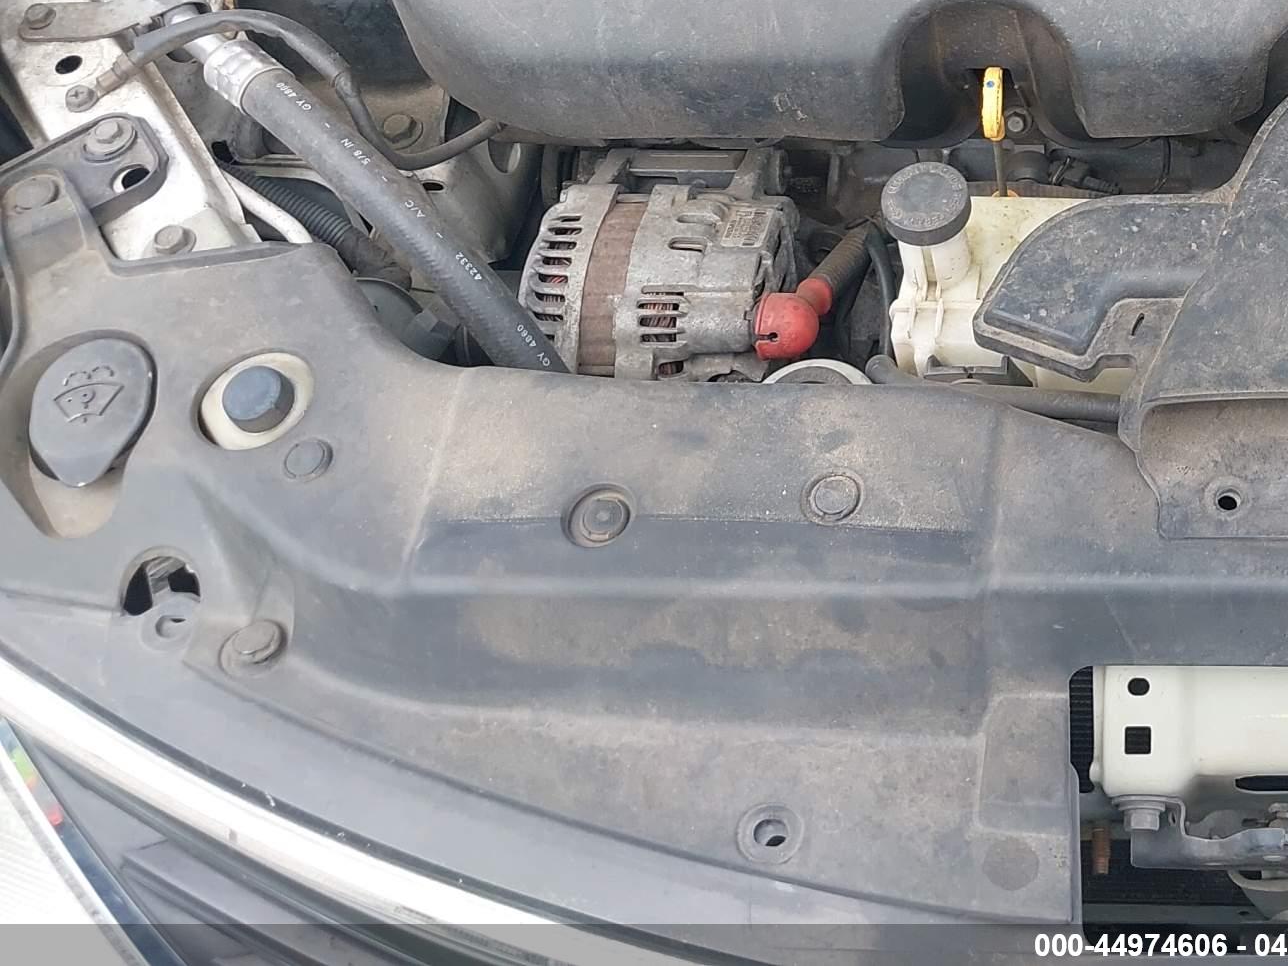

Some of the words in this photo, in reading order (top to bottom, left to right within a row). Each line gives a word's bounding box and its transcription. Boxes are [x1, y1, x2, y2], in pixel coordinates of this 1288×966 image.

[295, 98, 312, 111] GY
[341, 138, 354, 150] IN
[352, 148, 371, 166] 5/8
[404, 200, 426, 218] A/C
[455, 251, 482, 281] 42332
